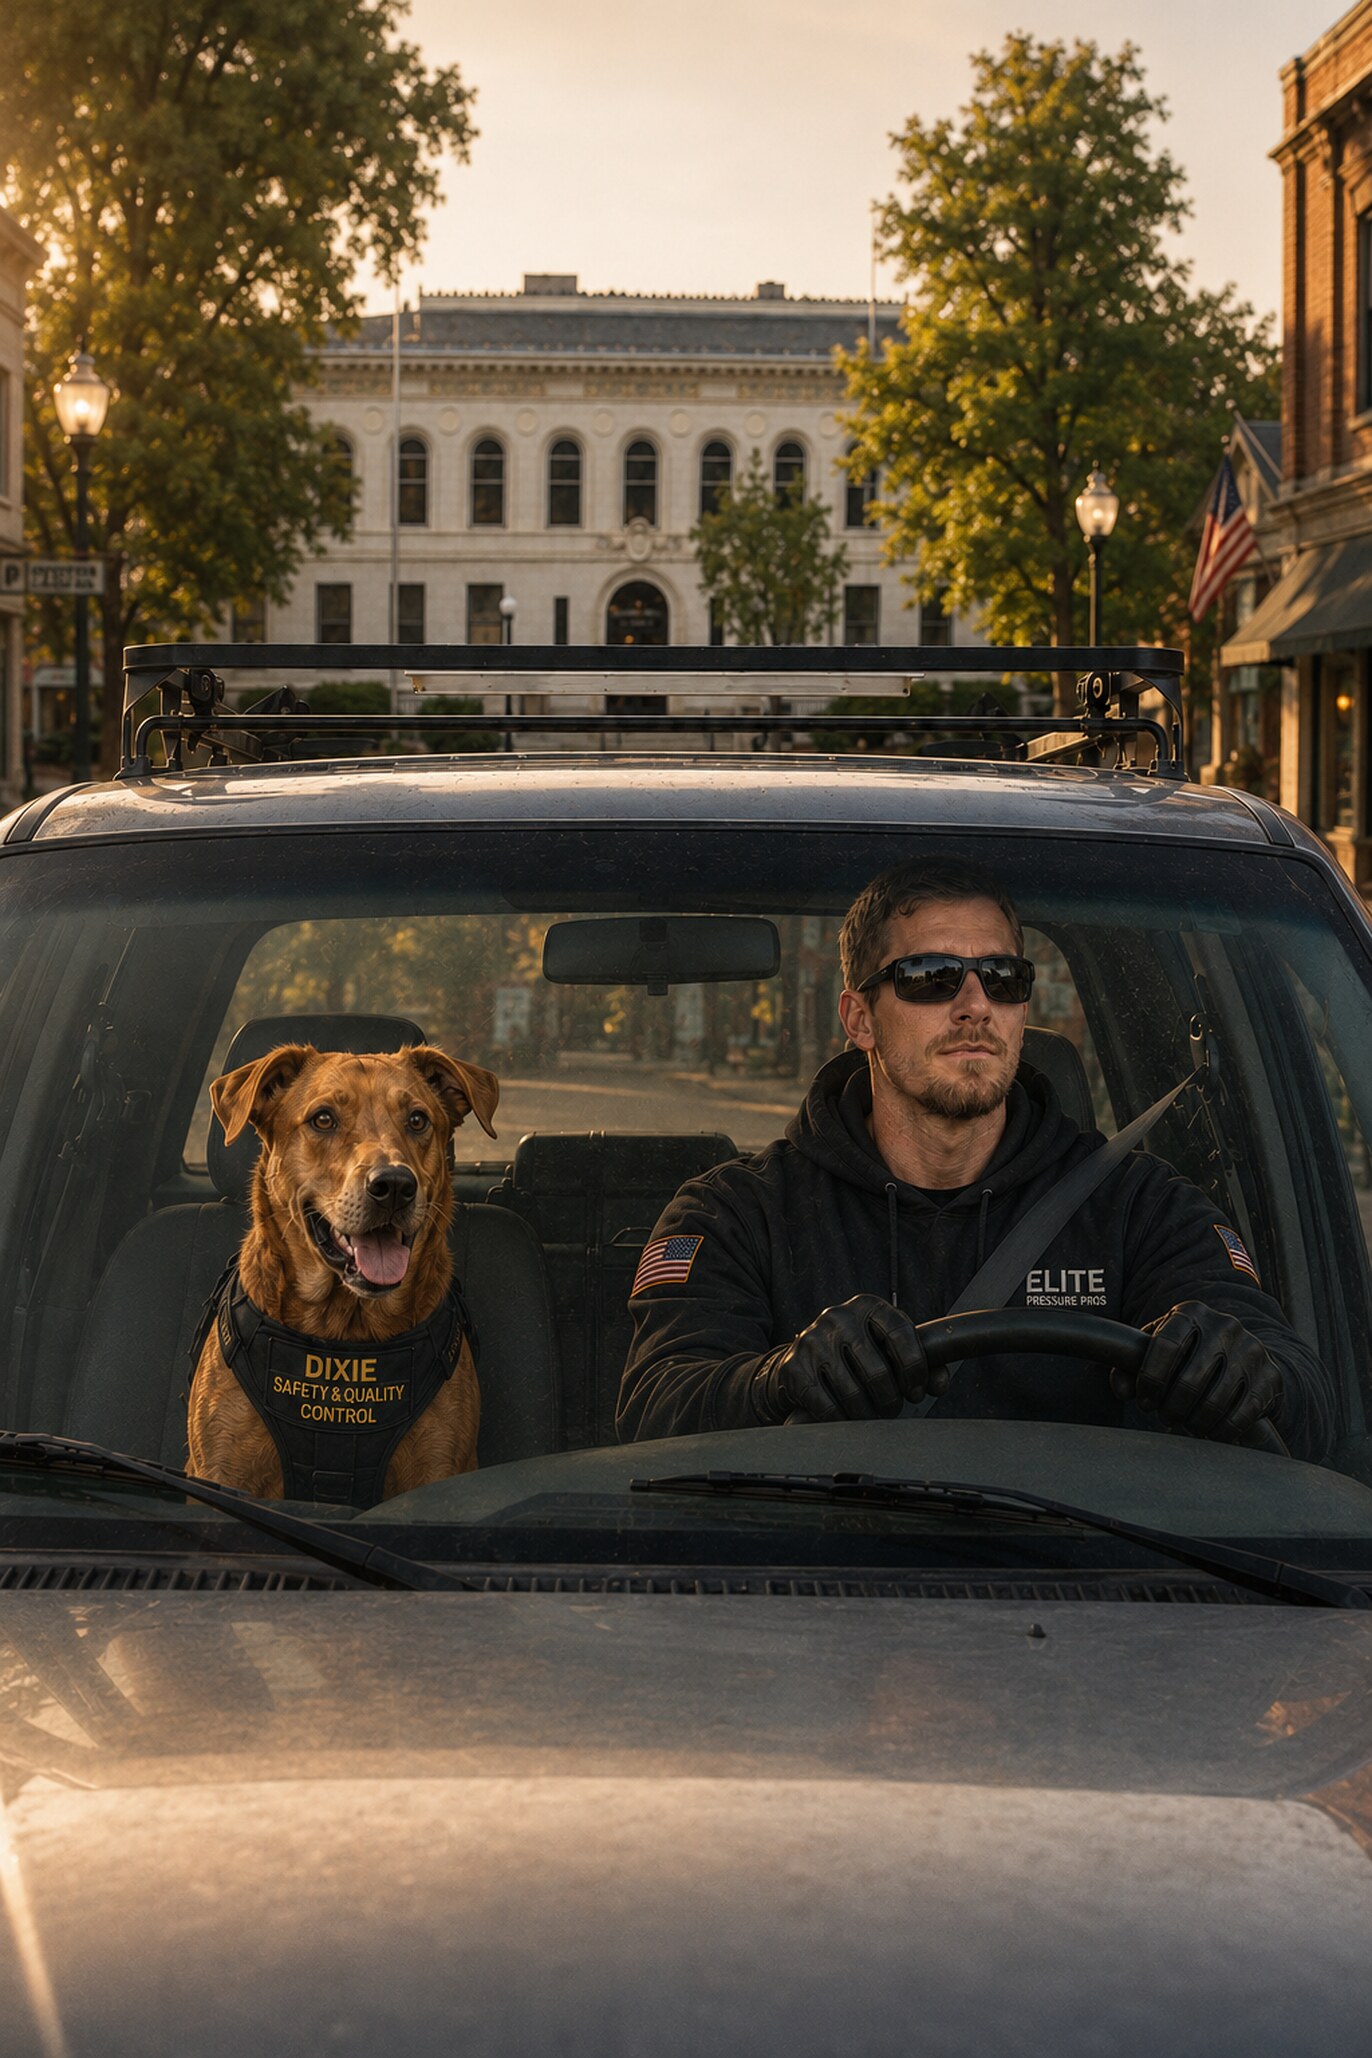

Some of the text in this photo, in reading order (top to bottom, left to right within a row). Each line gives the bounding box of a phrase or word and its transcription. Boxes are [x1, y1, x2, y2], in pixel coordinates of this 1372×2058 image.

[5, 565, 20, 587] P
[1026, 1269, 1105, 1293] ELITE
[1026, 1295, 1107, 1306] PRESSURE PROS
[305, 1354, 377, 1382] DIXIE
[273, 1376, 405, 1403] SAFETY & QUALITY
[300, 1403, 377, 1424] CONTROL
